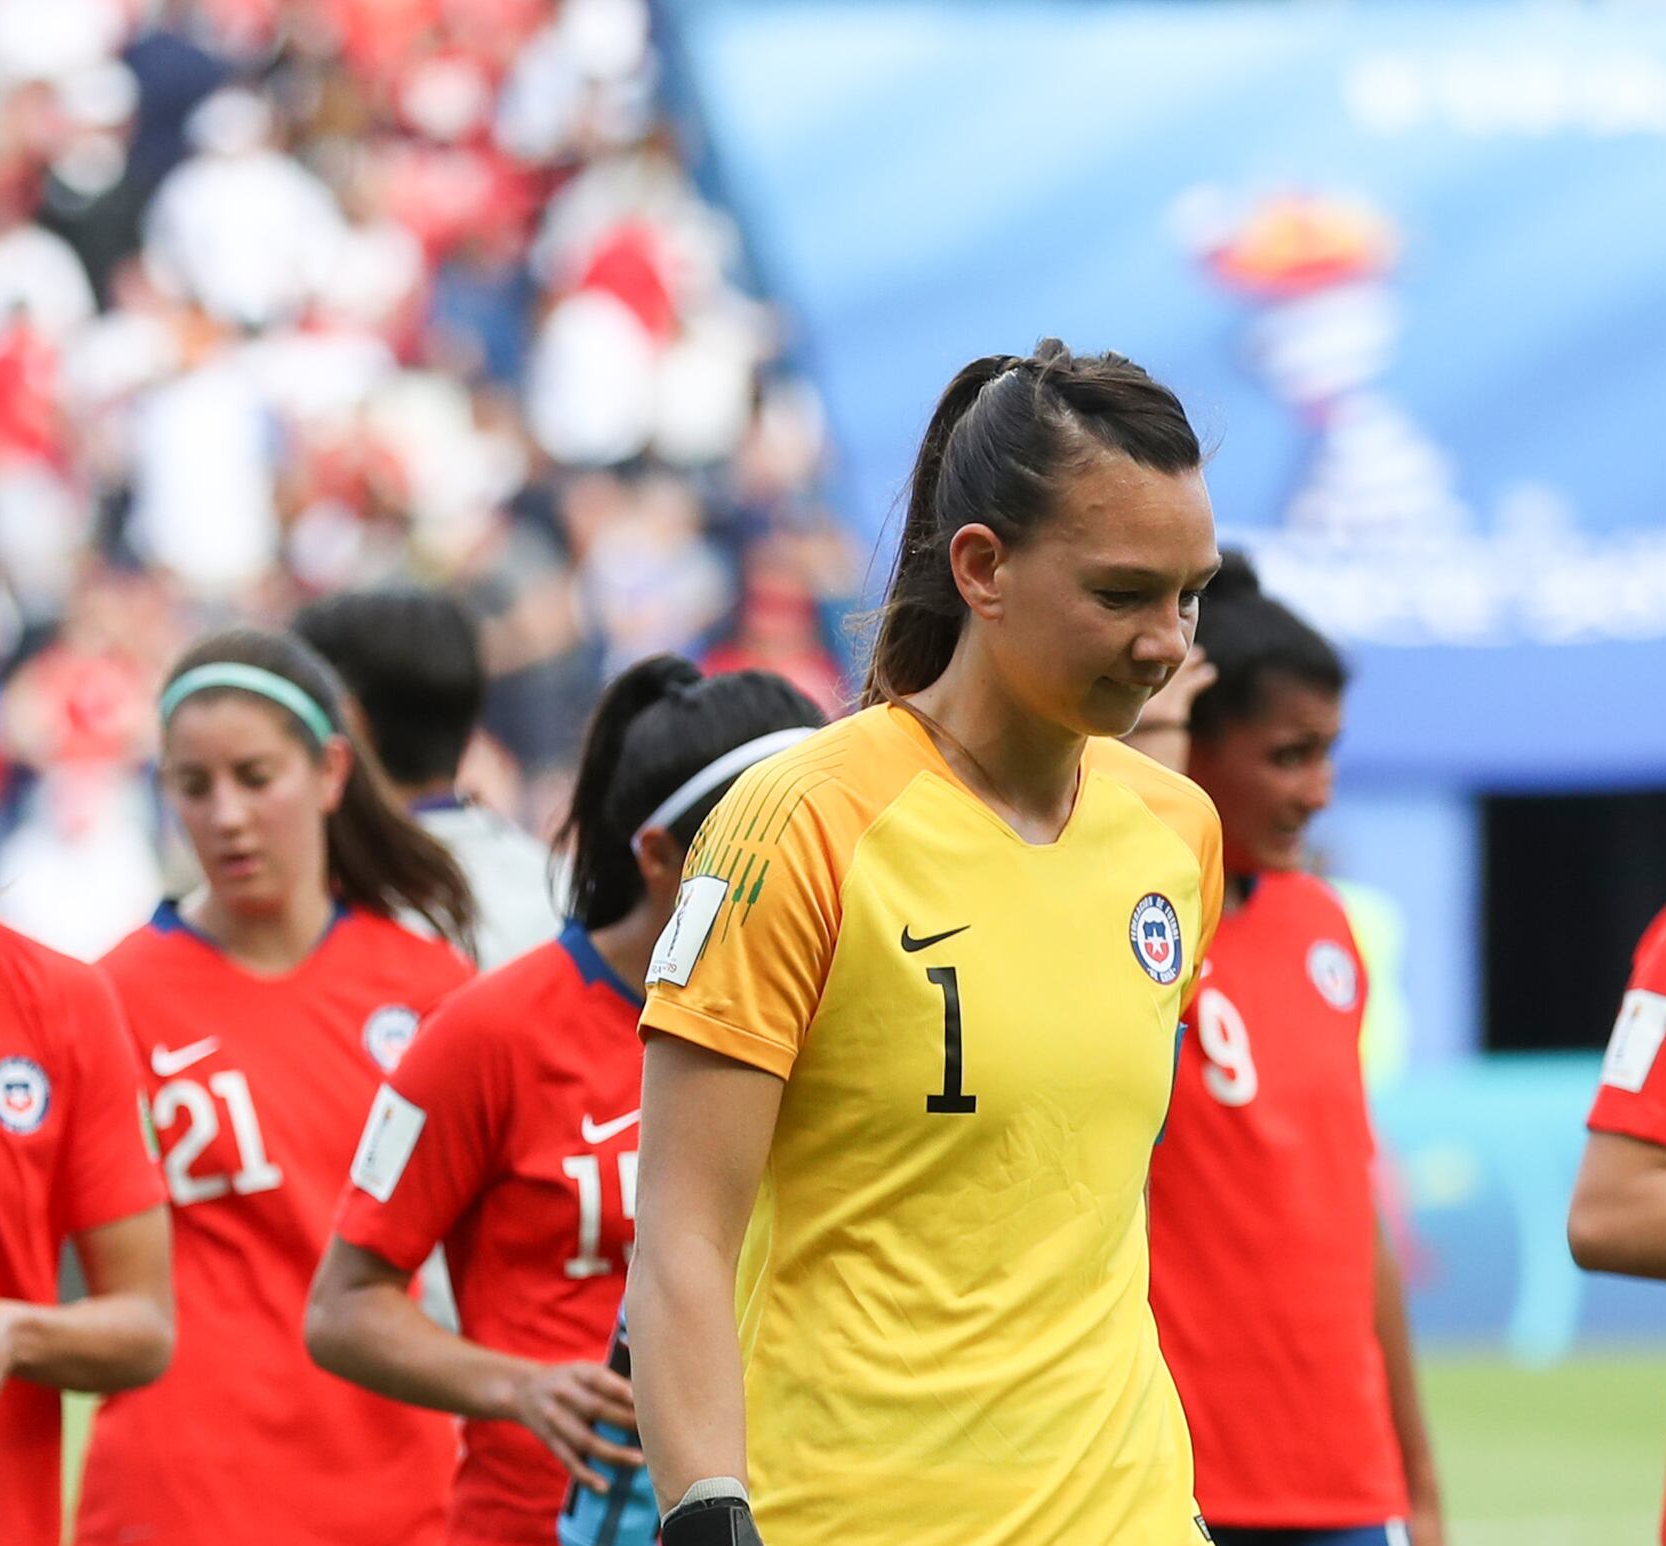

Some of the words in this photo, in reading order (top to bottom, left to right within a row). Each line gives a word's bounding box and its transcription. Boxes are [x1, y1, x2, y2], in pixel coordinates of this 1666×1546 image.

[926, 967, 976, 1113] 1
[1197, 987, 1258, 1107] 9
[152, 1069, 282, 1206] 21
